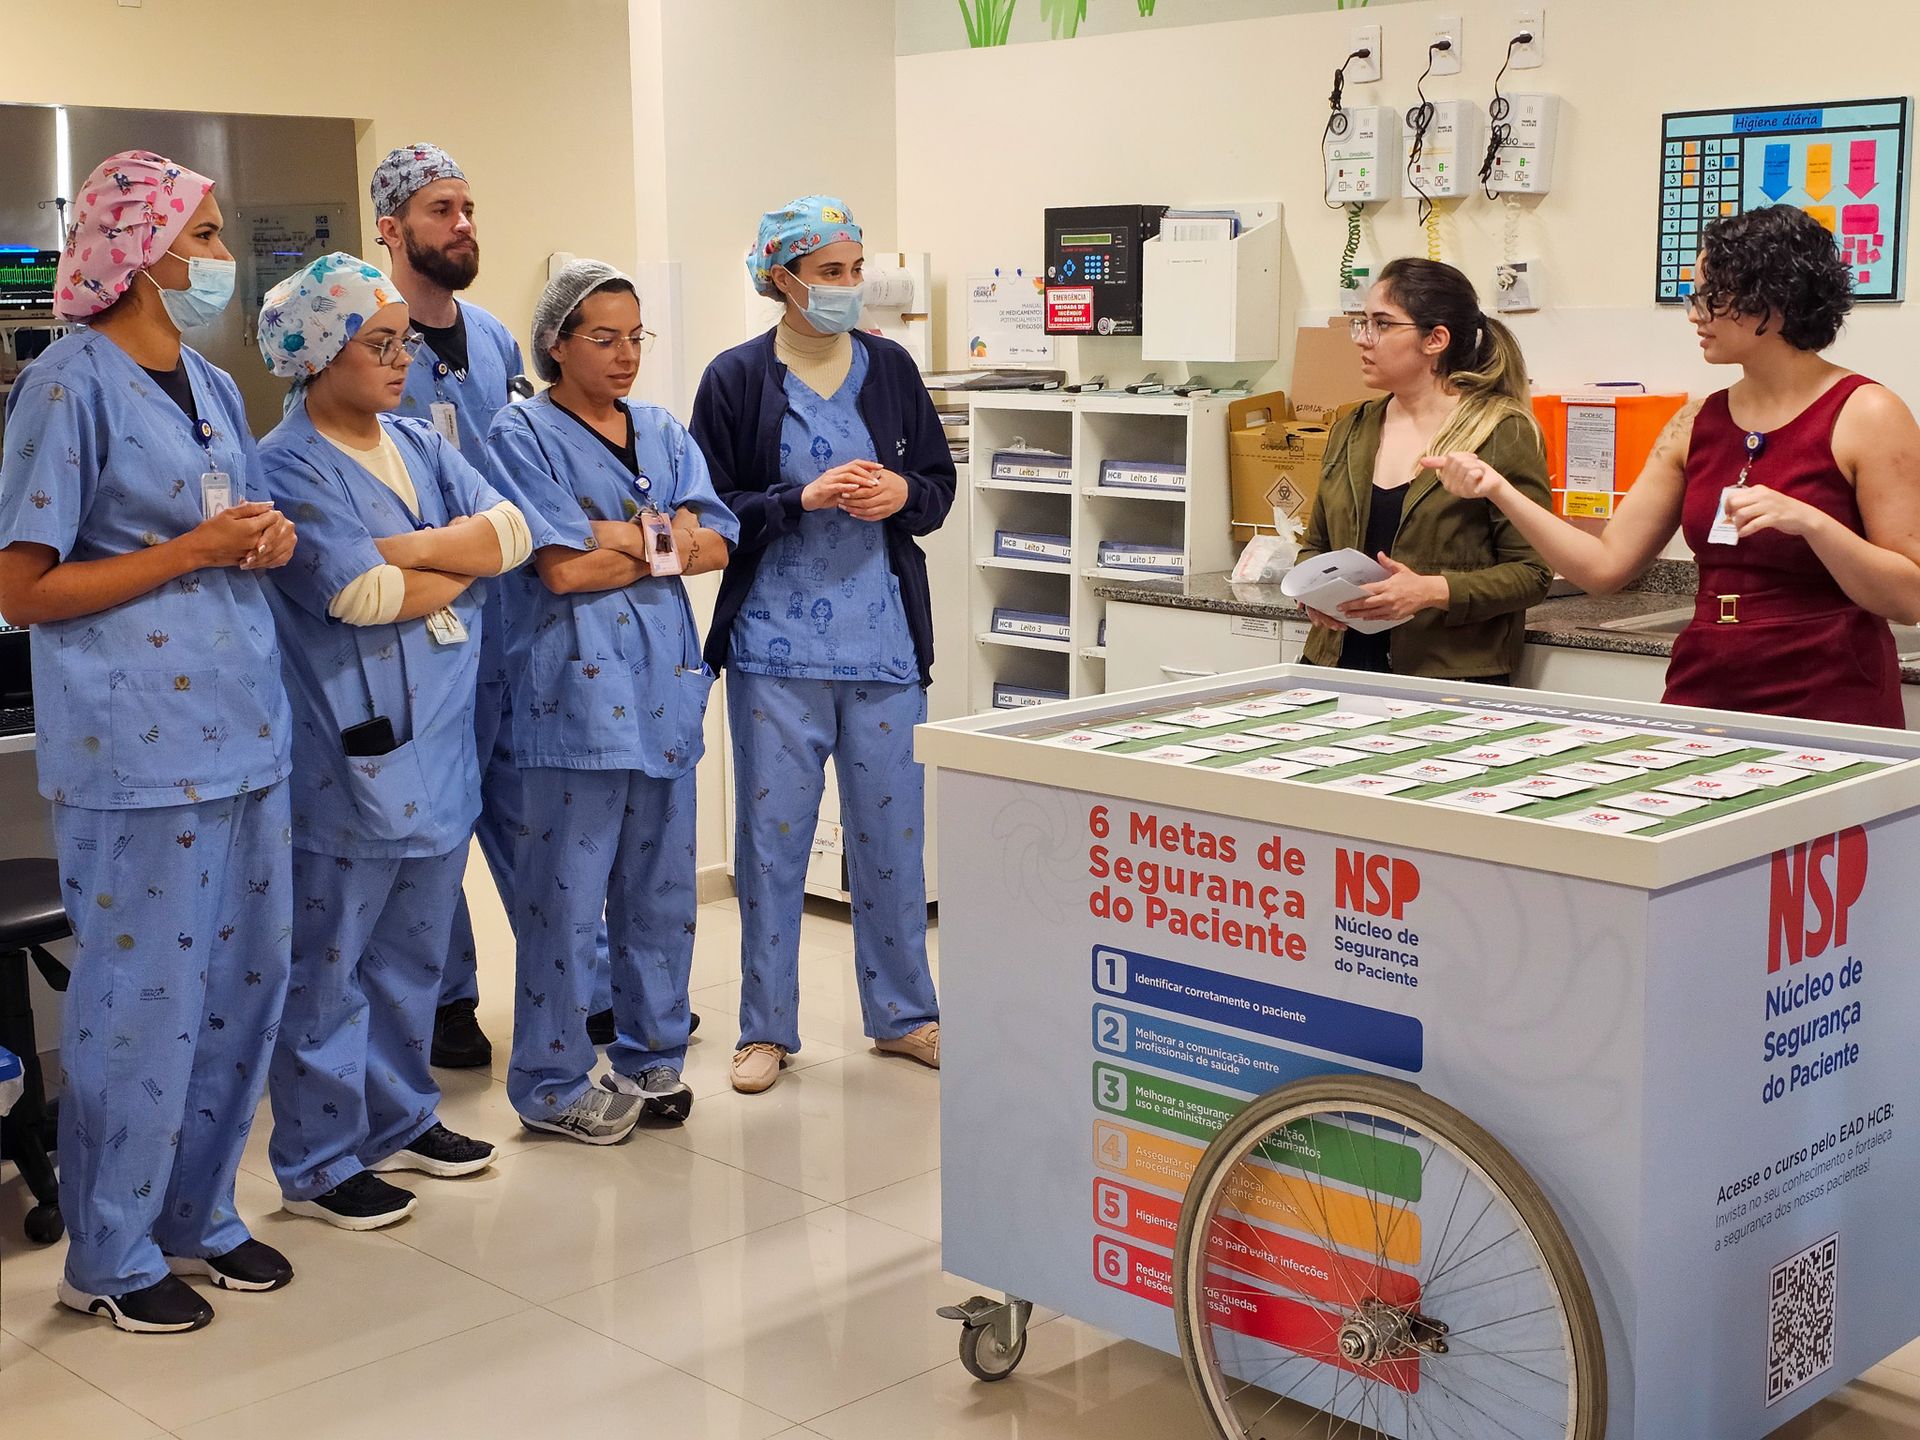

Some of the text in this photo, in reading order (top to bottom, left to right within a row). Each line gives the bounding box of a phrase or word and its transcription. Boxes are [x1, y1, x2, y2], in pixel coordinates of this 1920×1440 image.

[1735, 112, 1818, 132] Higiene diária
[1670, 160, 1677, 169] 2
[1708, 159, 1717, 168] 12
[1670, 175, 1676, 184] 3
[1707, 174, 1716, 183] 13
[1669, 191, 1675, 200] 4
[1669, 206, 1675, 216] 5
[1706, 205, 1715, 214] 15
[1670, 221, 1675, 229] 6
[1669, 237, 1673, 246] 7
[1667, 252, 1673, 262] 8
[1666, 269, 1671, 278] 9
[1053, 292, 1086, 301] EMERGÊNCIA
[1665, 285, 1672, 293] 10
[998, 464, 1011, 474] HCB
[1019, 468, 1035, 477] Leito
[1058, 470, 1069, 479] UTI
[1107, 471, 1185, 485] HCB Leito 16 UTI
[1004, 538, 1017, 547] HCB
[1025, 542, 1040, 552] Leito
[1107, 554, 1121, 562] HCB
[1129, 555, 1146, 564] Leito
[1171, 557, 1183, 566] UTI
[747, 610, 771, 620] HCB
[1000, 620, 1012, 629] HCB
[1020, 623, 1036, 632] Leito
[832, 666, 858, 675] HCB
[1000, 695, 1012, 703] HCB
[1020, 697, 1036, 706] Leito
[1466, 698, 1697, 731] CAMPO MINADO
[1797, 754, 1826, 763] NSP
[1745, 767, 1775, 776] NSP
[1694, 780, 1723, 791] NSP
[1590, 812, 1621, 822] NSP
[1088, 805, 1306, 876] 6 Metas de
[1088, 846, 1306, 920] Segurança
[1334, 847, 1421, 921] NSP
[1767, 824, 1869, 975] NSP
[1089, 885, 1307, 962] do Paciente
[1334, 915, 1419, 946] Núcleo de
[1334, 936, 1419, 968] Segurança
[1104, 958, 1117, 986] 1
[1334, 958, 1418, 988] do Paciente
[1134, 972, 1306, 1024] Identificar corretamente o paciente
[1765, 956, 1863, 1021] Núcleo de
[1102, 1017, 1120, 1046] 2
[1763, 1000, 1861, 1062] Segurança
[1135, 1027, 1280, 1074] Melhorar a comunicação entre
[1135, 1039, 1240, 1076] profissionais de saúde
[1762, 1042, 1859, 1104] do Paciente
[1102, 1076, 1120, 1103] 3
[1135, 1086, 1176, 1105] Melhorar
[1178, 1099, 1184, 1107] a
[1135, 1099, 1224, 1130] uso e administraçã
[1274, 1129, 1307, 1144] crição,
[1102, 1134, 1121, 1161] 4
[1136, 1146, 1181, 1166] Assegurar
[1262, 1136, 1321, 1159] dicamentos
[1716, 1103, 1894, 1206] Acesse o curso pelo EAD HCB:
[1135, 1159, 1192, 1181] procedimen
[1715, 1128, 1893, 1229] Invista no seu conhecimento e fortaleça
[1240, 1176, 1267, 1194] local,
[1104, 1190, 1120, 1219] 5
[1256, 1196, 1297, 1214] corretos
[1714, 1157, 1871, 1252] a segurança dos nossos pacientes!
[1136, 1209, 1178, 1231] Higieniza
[1104, 1249, 1120, 1276] 6
[1210, 1235, 1329, 1281] os para evitar infecções
[1136, 1263, 1172, 1283] Reduzir
[1136, 1275, 1173, 1294] e lesões
[1207, 1289, 1258, 1313] de quedas
[1207, 1301, 1231, 1315] ssão
